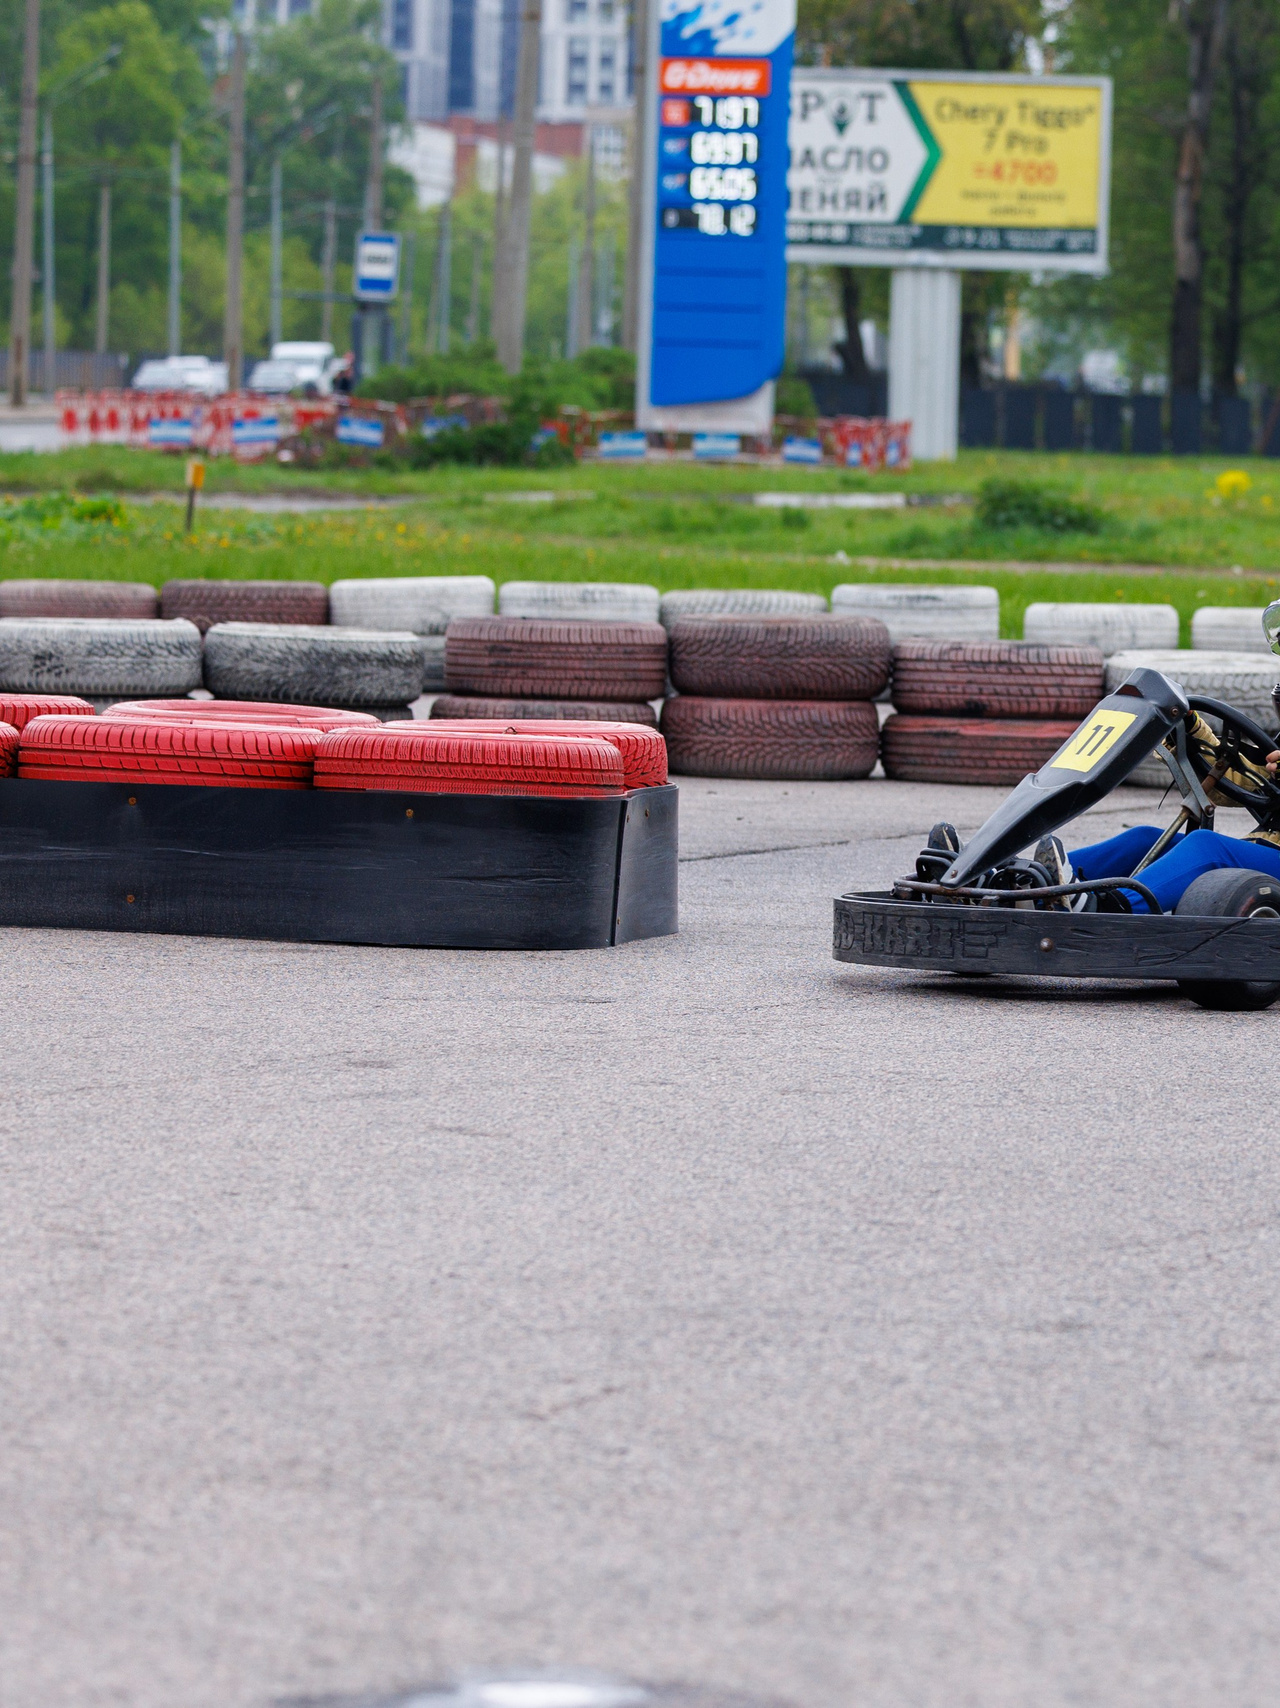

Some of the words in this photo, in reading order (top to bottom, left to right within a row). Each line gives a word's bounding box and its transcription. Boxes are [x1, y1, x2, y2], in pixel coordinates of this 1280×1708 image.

[791, 147, 890, 173] АСЛО
[791, 182, 887, 213] ЕНЯЙ
[1075, 723, 1116, 757] 11
